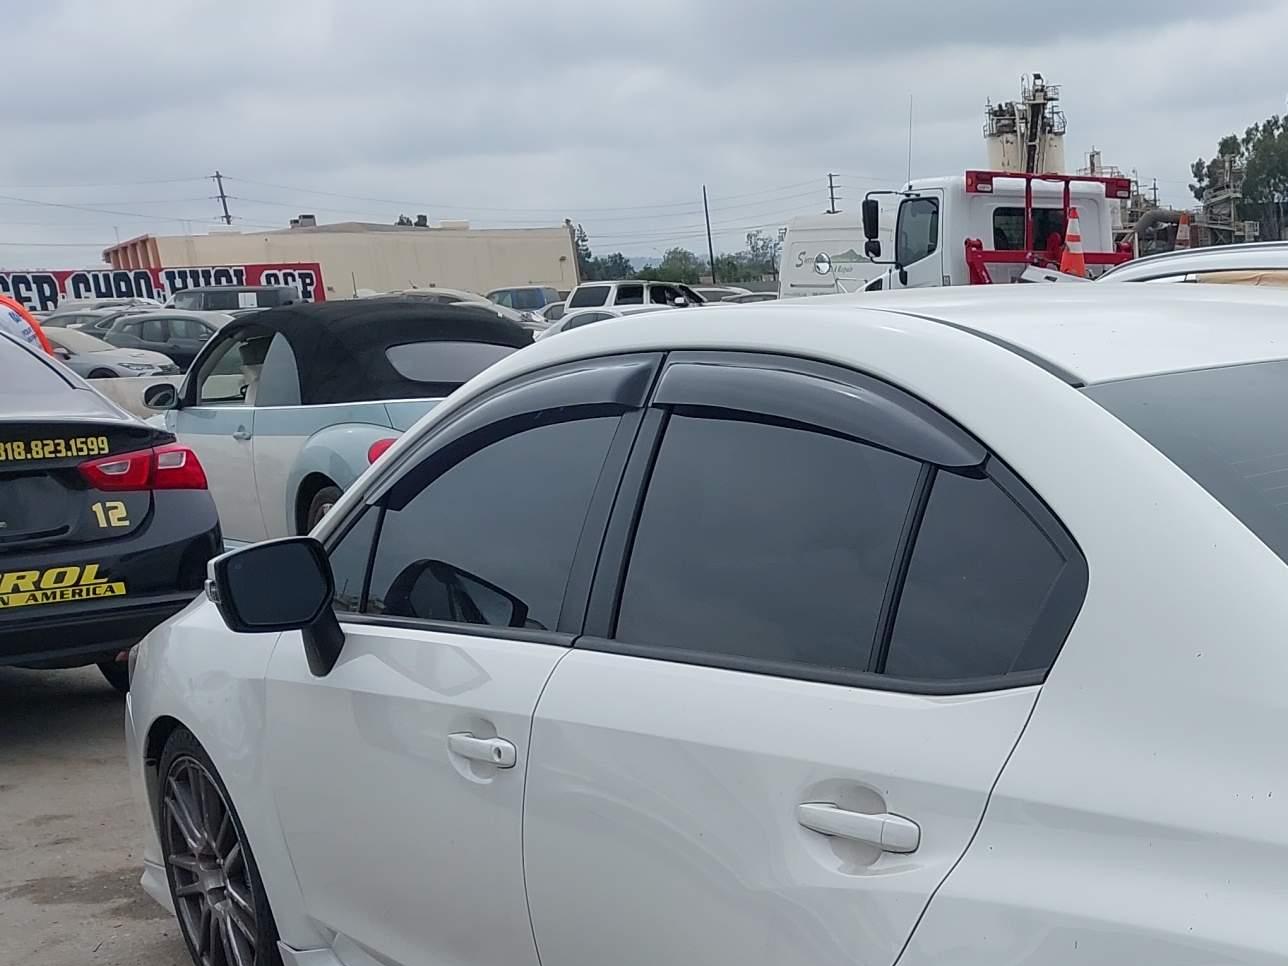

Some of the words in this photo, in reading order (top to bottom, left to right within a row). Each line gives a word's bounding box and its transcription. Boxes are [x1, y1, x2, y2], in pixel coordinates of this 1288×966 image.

[92, 501, 130, 528] 12
[0, 563, 109, 593] ROL
[25, 583, 116, 605] AMERICA
